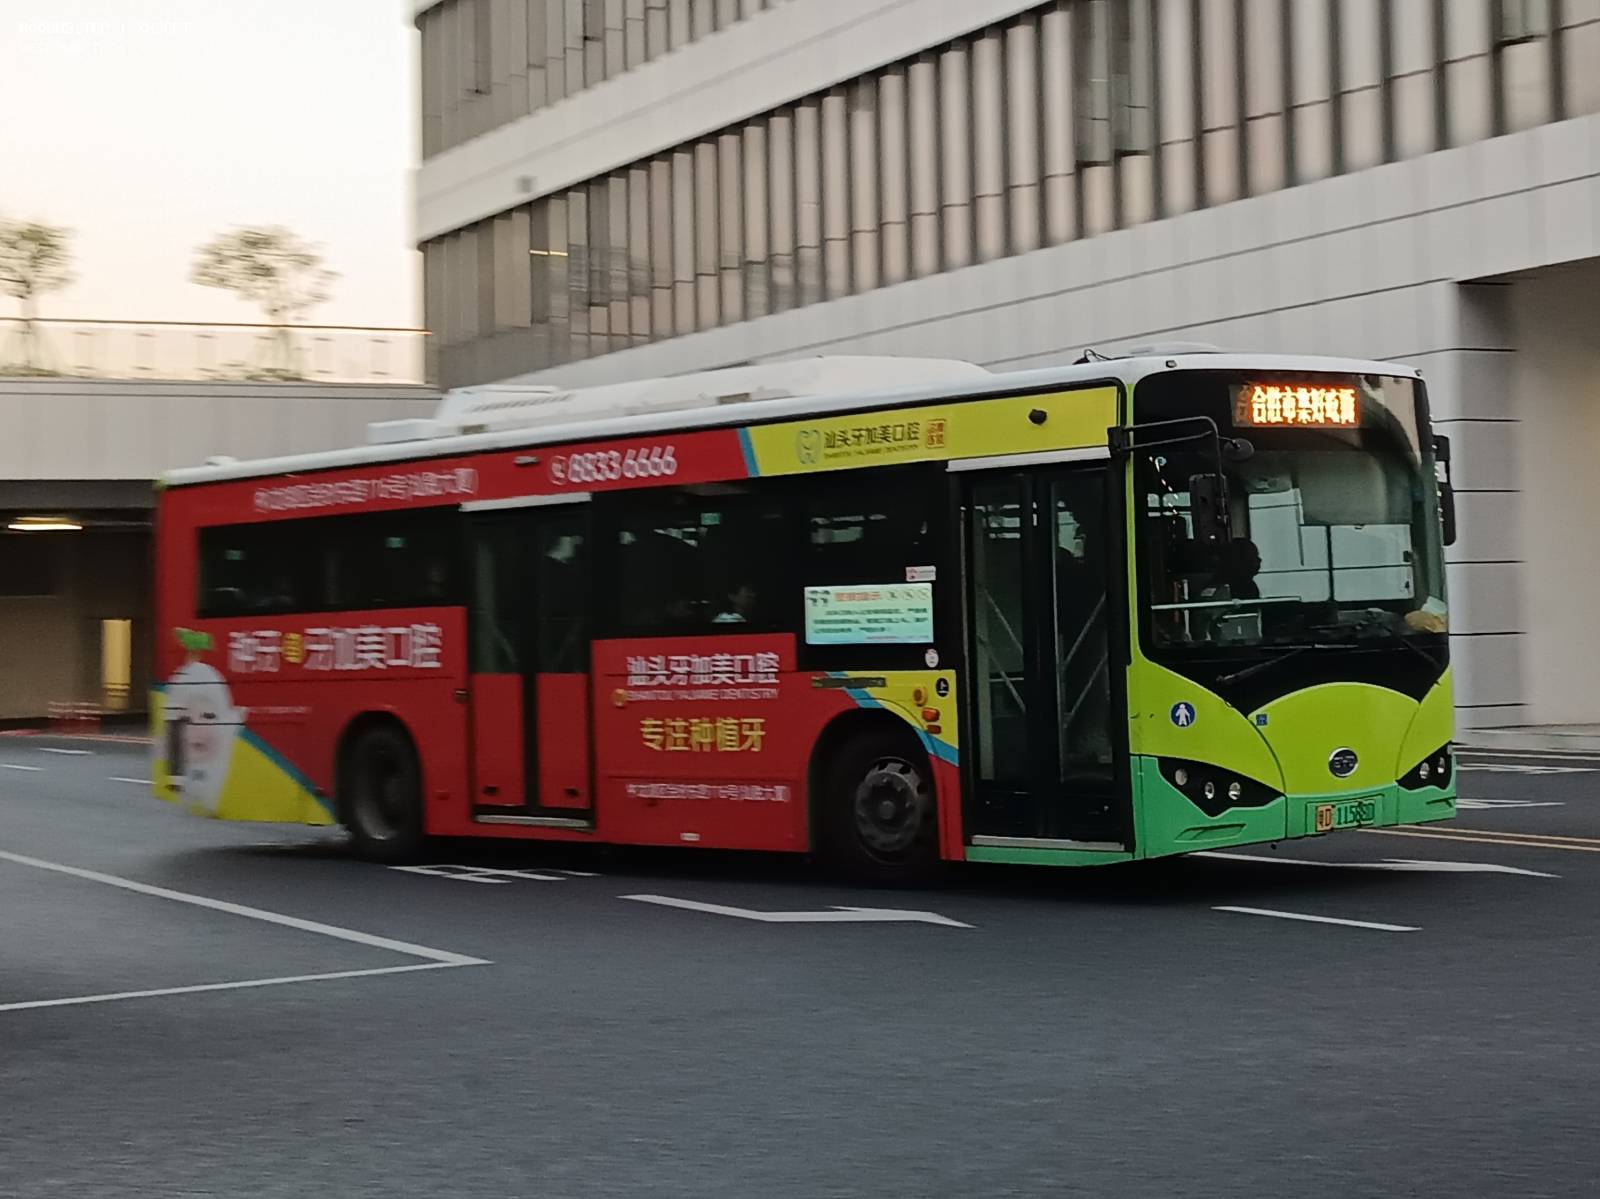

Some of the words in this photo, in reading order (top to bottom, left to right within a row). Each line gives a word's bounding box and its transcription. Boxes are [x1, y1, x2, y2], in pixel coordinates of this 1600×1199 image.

[823, 422, 920, 448] 汕头牙加美口腔
[626, 652, 780, 686] 汕头牙加美口腔
[640, 717, 767, 752] 专注种植牙
